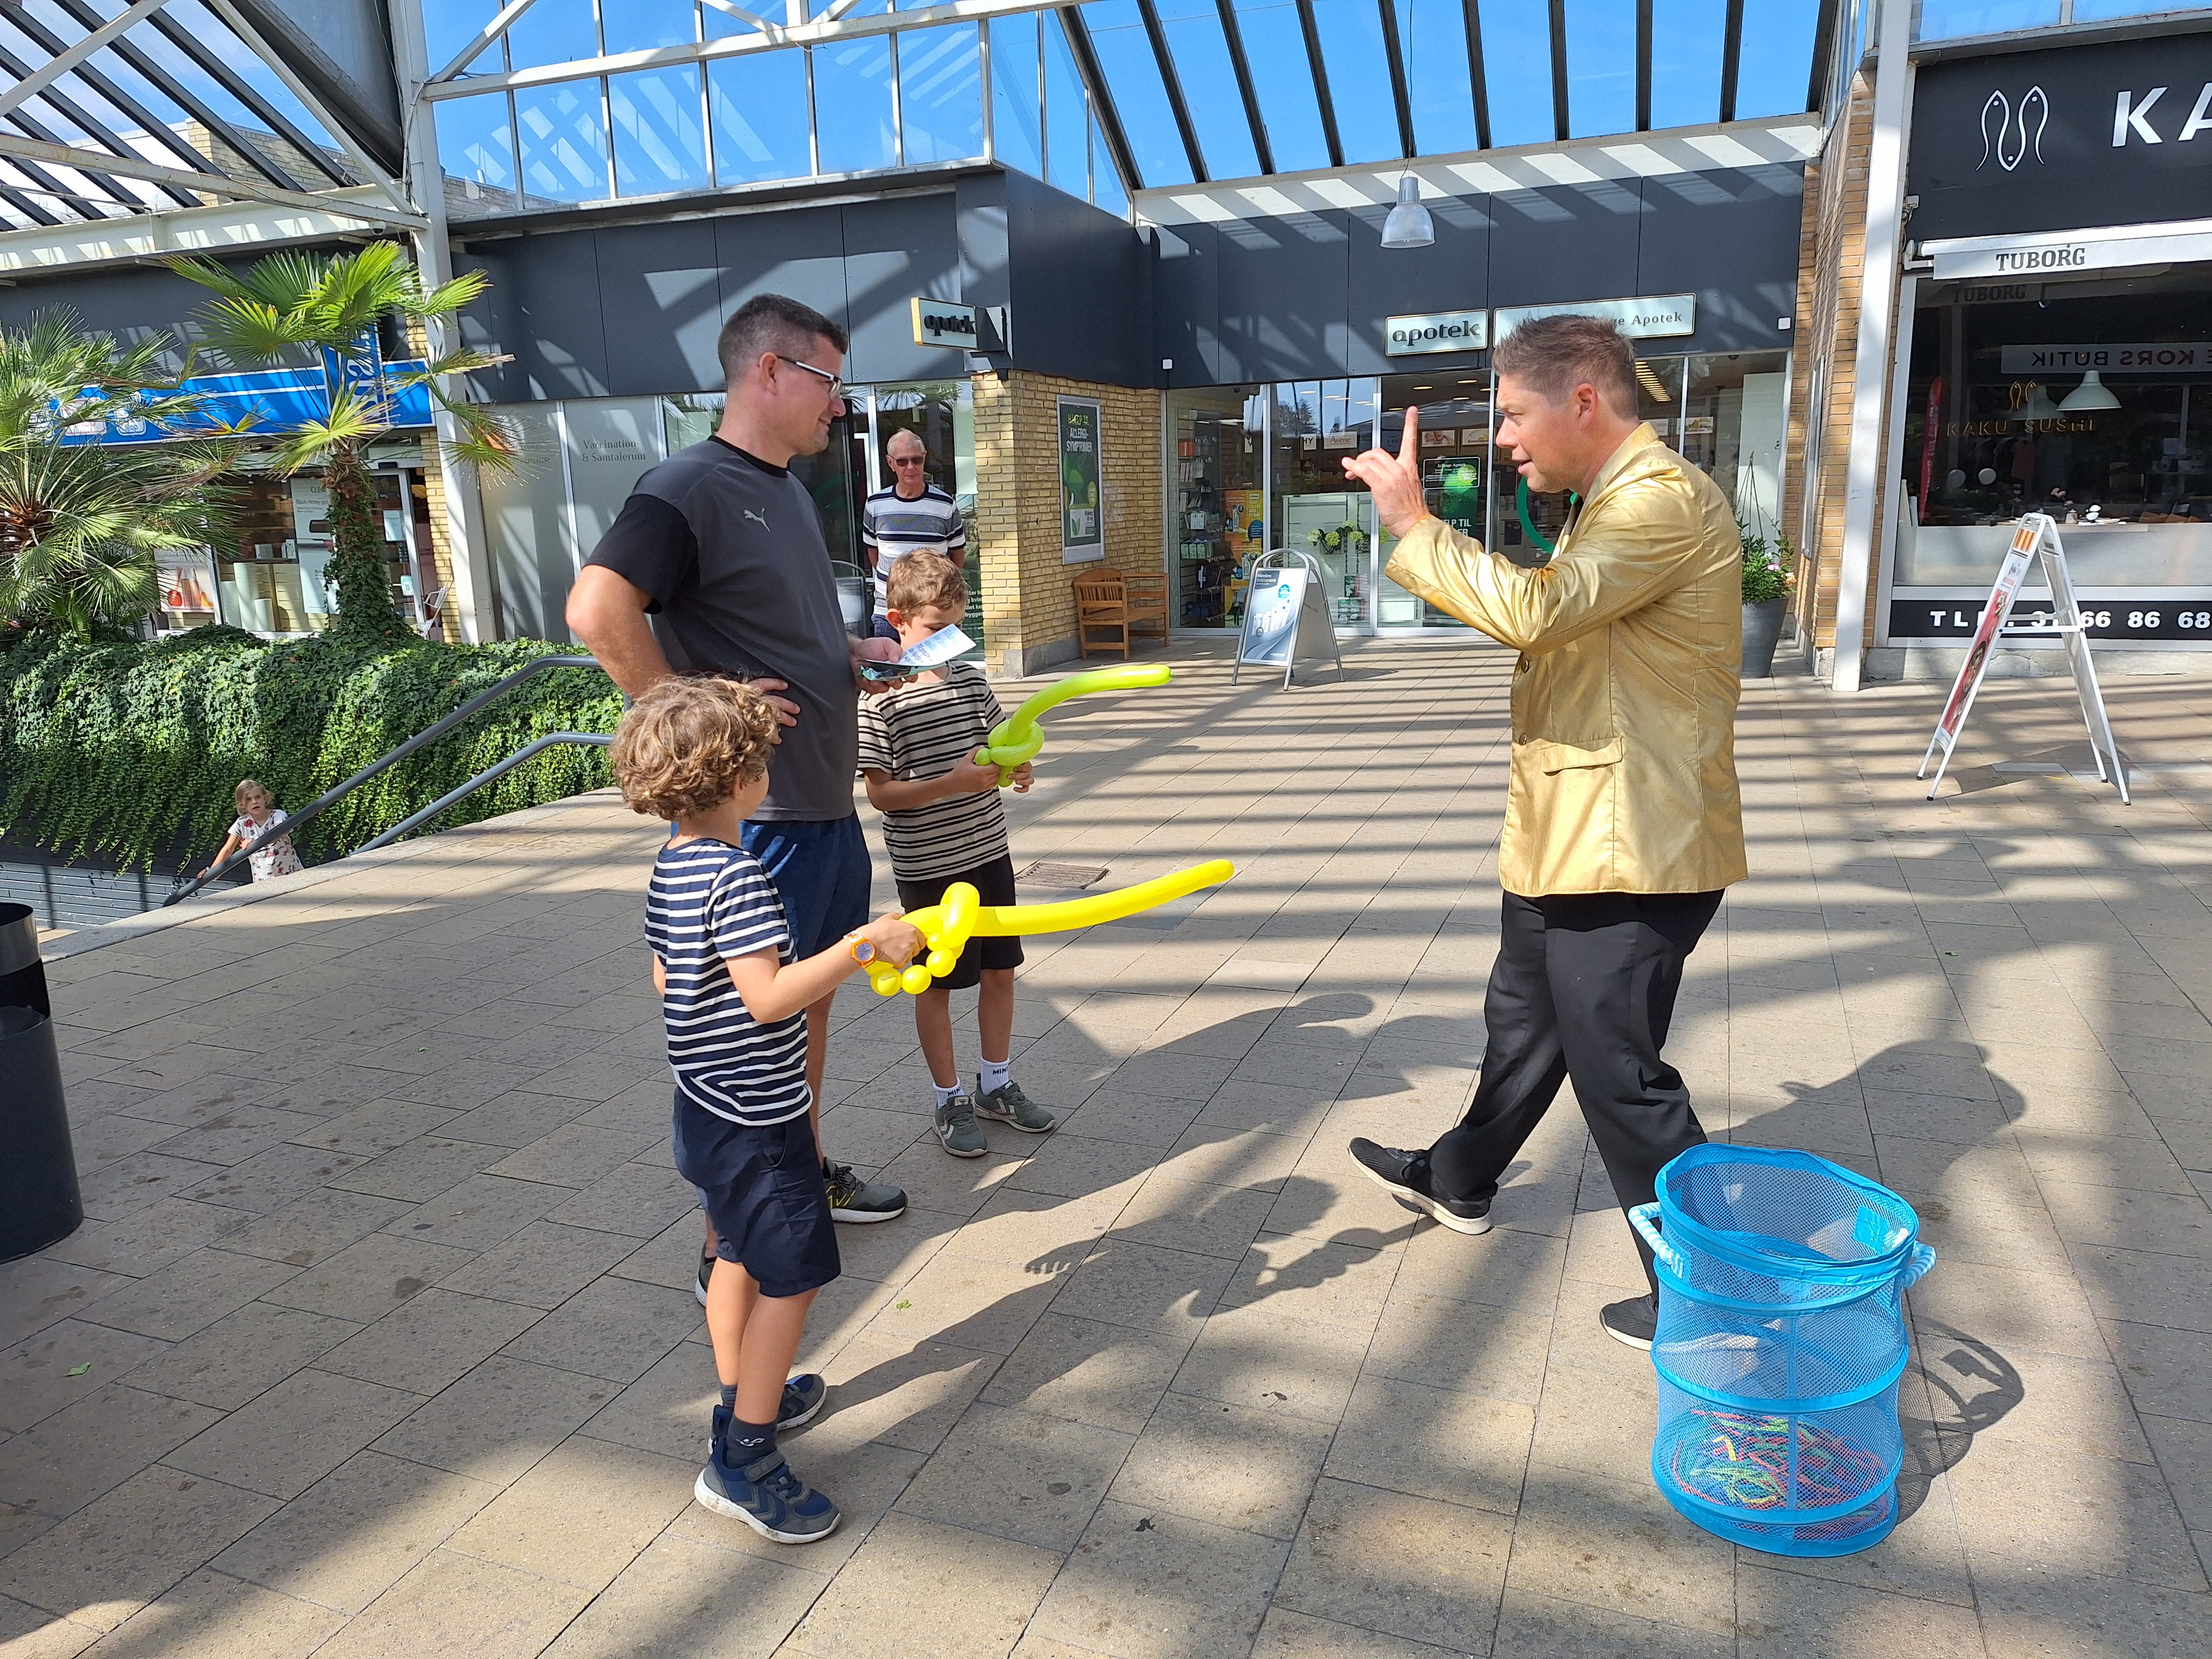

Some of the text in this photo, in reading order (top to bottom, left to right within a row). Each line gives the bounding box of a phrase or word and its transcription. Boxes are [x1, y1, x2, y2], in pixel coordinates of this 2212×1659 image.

[1996, 247, 2086, 272] TUBORG
[1954, 285, 2026, 303] TUBORG
[1631, 311, 1682, 326] Apotek
[1392, 320, 1481, 346] apotek
[1947, 420, 2007, 437] KAKU
[1066, 440, 1092, 453] SYMPTOMER
[582, 452, 646, 462] & Samtalerum
[1458, 518, 1472, 527] TIL
[2080, 610, 2112, 628] 66
[2127, 611, 2161, 628] 86
[2178, 612, 2211, 629] 68
